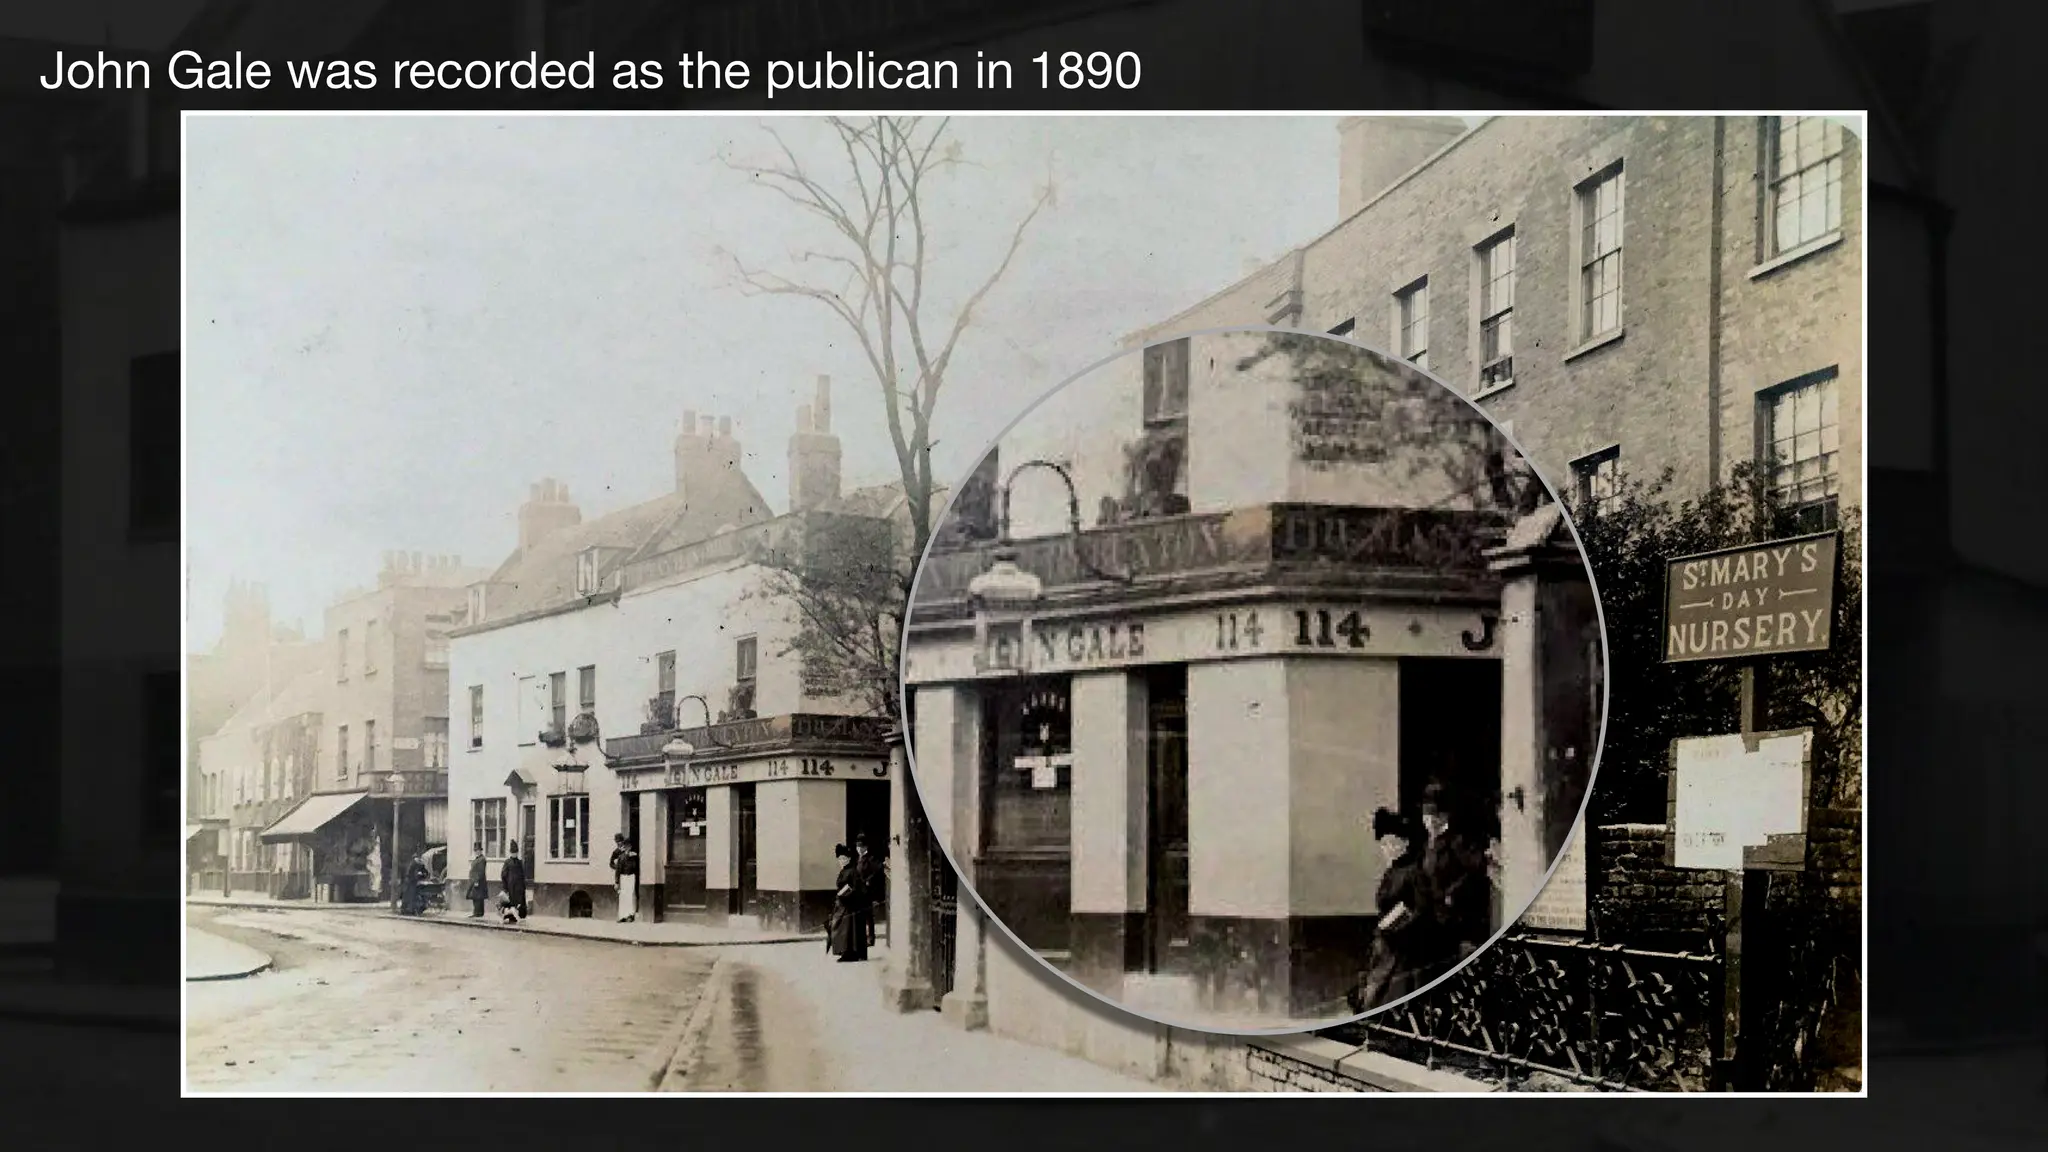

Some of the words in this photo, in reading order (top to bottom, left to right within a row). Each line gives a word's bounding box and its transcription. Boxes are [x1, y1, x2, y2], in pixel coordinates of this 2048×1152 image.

[1722, 587, 1769, 611] DAY
[1067, 619, 1145, 662] GALE
[1214, 609, 1264, 650] 114
[1294, 608, 1371, 649] 114
[704, 763, 738, 782] GALE
[768, 759, 789, 777] 114
[802, 758, 834, 776] 114
